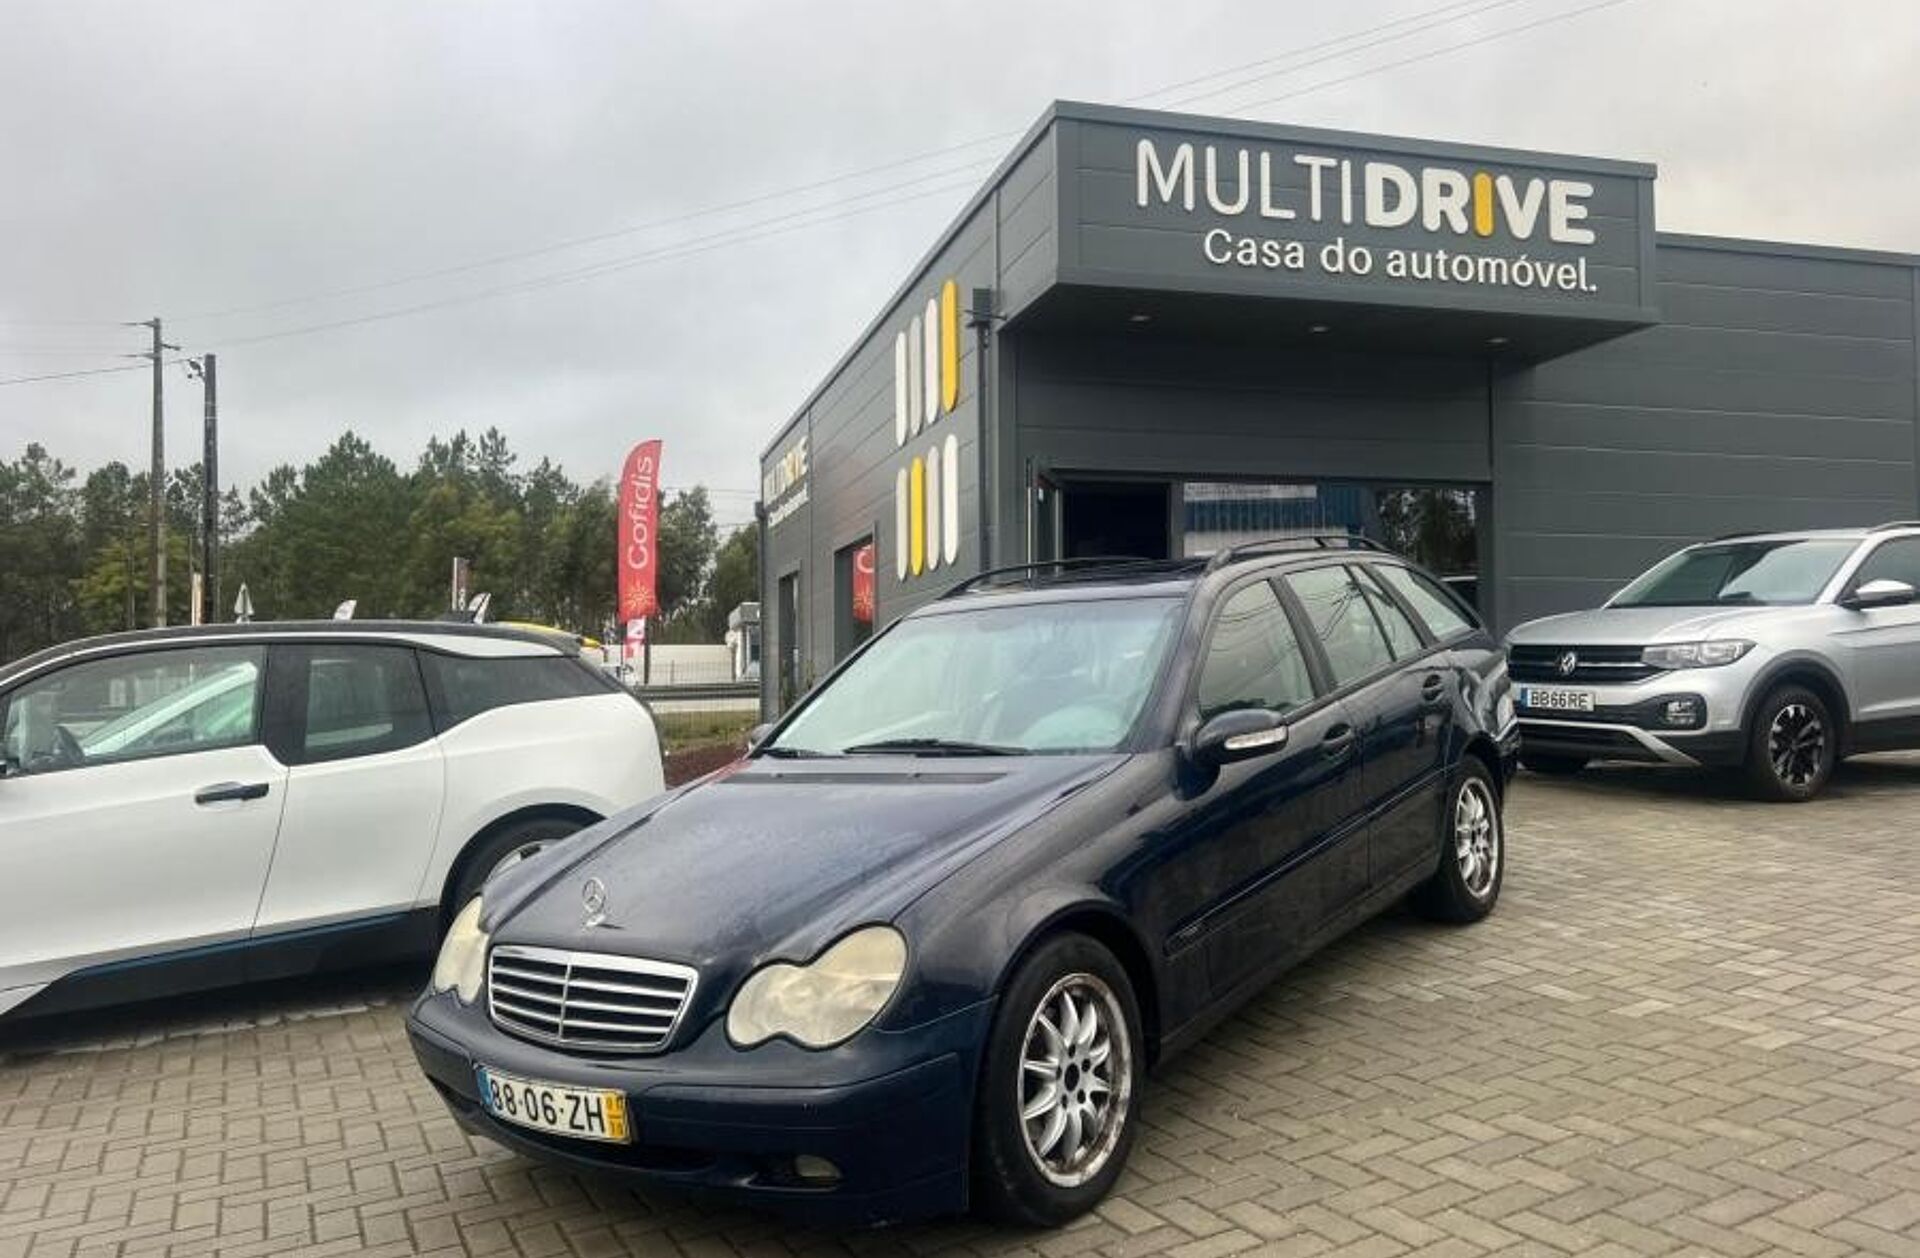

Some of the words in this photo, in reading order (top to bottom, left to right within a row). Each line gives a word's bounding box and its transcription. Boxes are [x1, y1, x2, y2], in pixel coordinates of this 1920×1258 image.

[1136, 138, 1596, 245] MULTIDRIVE
[1204, 229, 1304, 268] Casa
[1320, 237, 1373, 274] do
[1386, 249, 1598, 292] automóvel.
[627, 456, 653, 569] Cofidis
